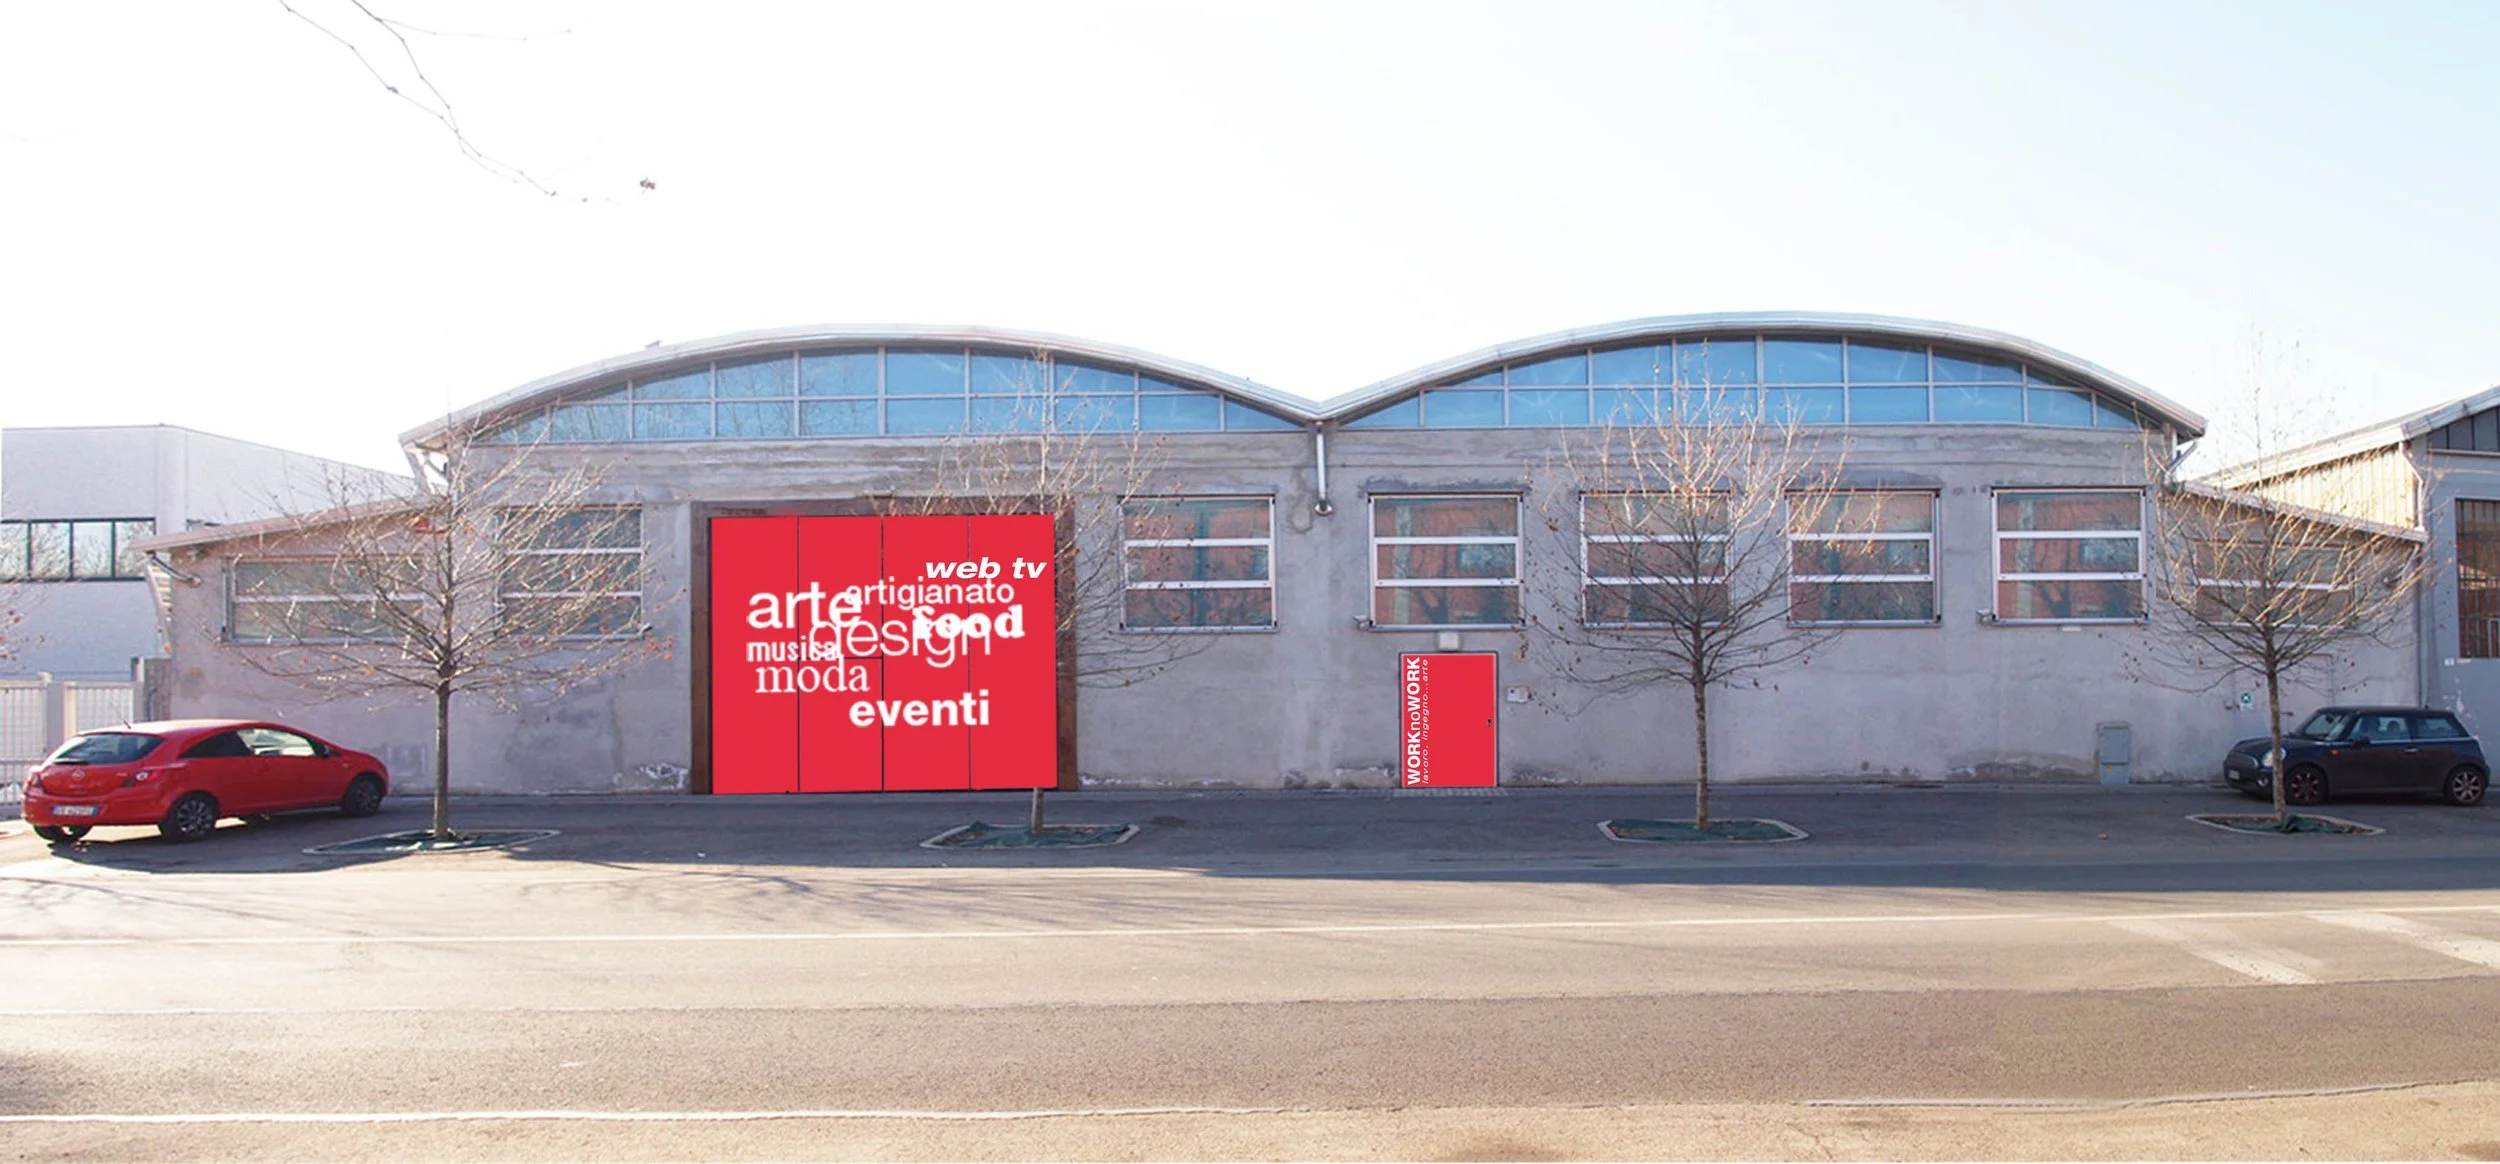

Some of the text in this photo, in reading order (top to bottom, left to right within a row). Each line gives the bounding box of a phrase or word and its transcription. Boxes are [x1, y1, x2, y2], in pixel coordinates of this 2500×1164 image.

[925, 557, 1047, 579] web tv
[747, 581, 862, 629] arte
[844, 576, 1015, 611] artigianato
[808, 606, 991, 668] design
[912, 604, 1026, 639] food
[747, 635, 838, 662] musica
[755, 653, 871, 693] moda
[849, 689, 989, 727] eventi
